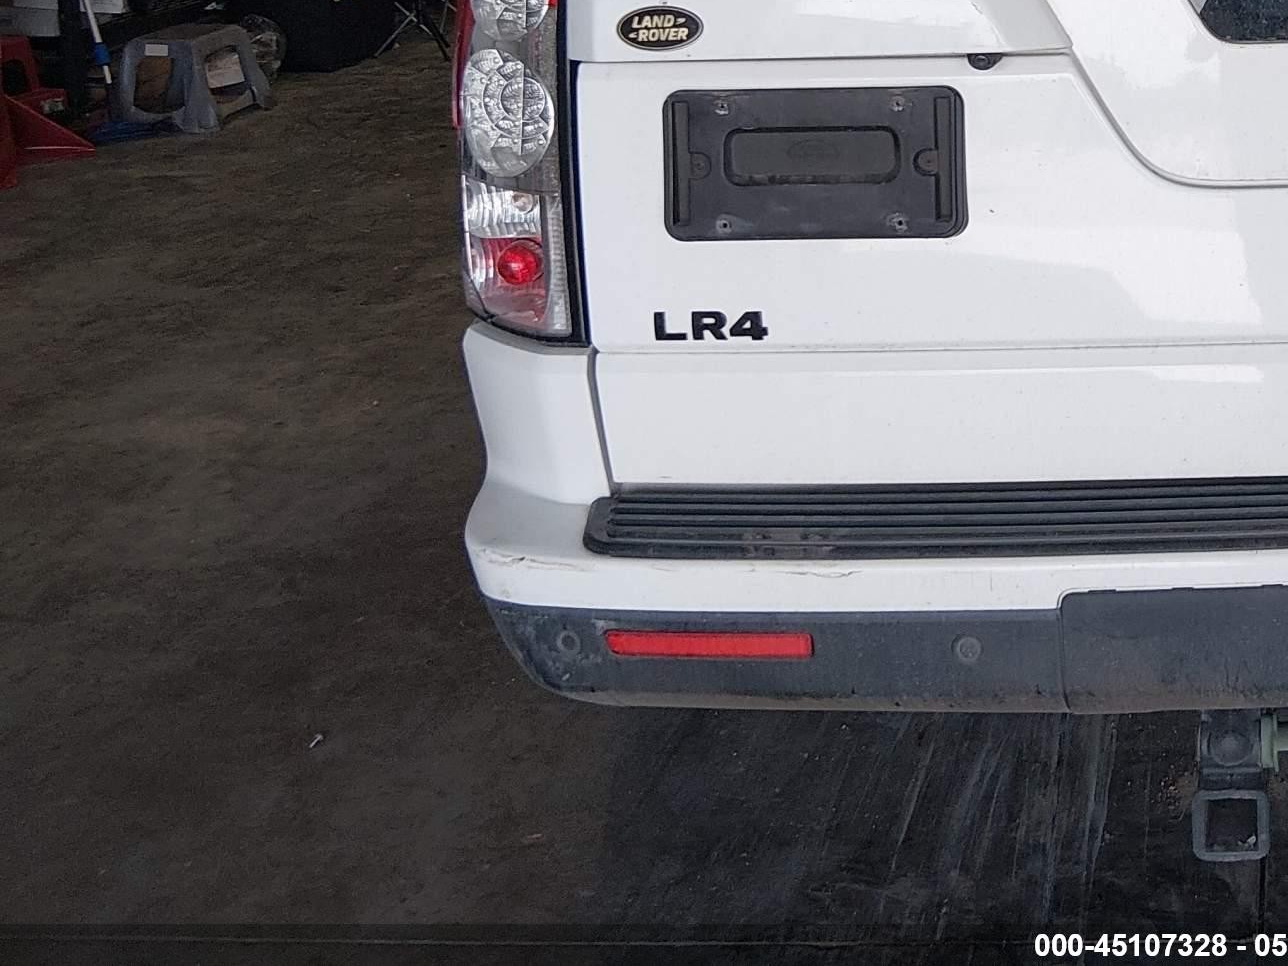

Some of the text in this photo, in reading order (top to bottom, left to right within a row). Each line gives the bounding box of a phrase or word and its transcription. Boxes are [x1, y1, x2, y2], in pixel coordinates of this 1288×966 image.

[632, 15, 675, 28] LAND
[638, 27, 689, 41] ROVER
[653, 311, 769, 340] LR4
